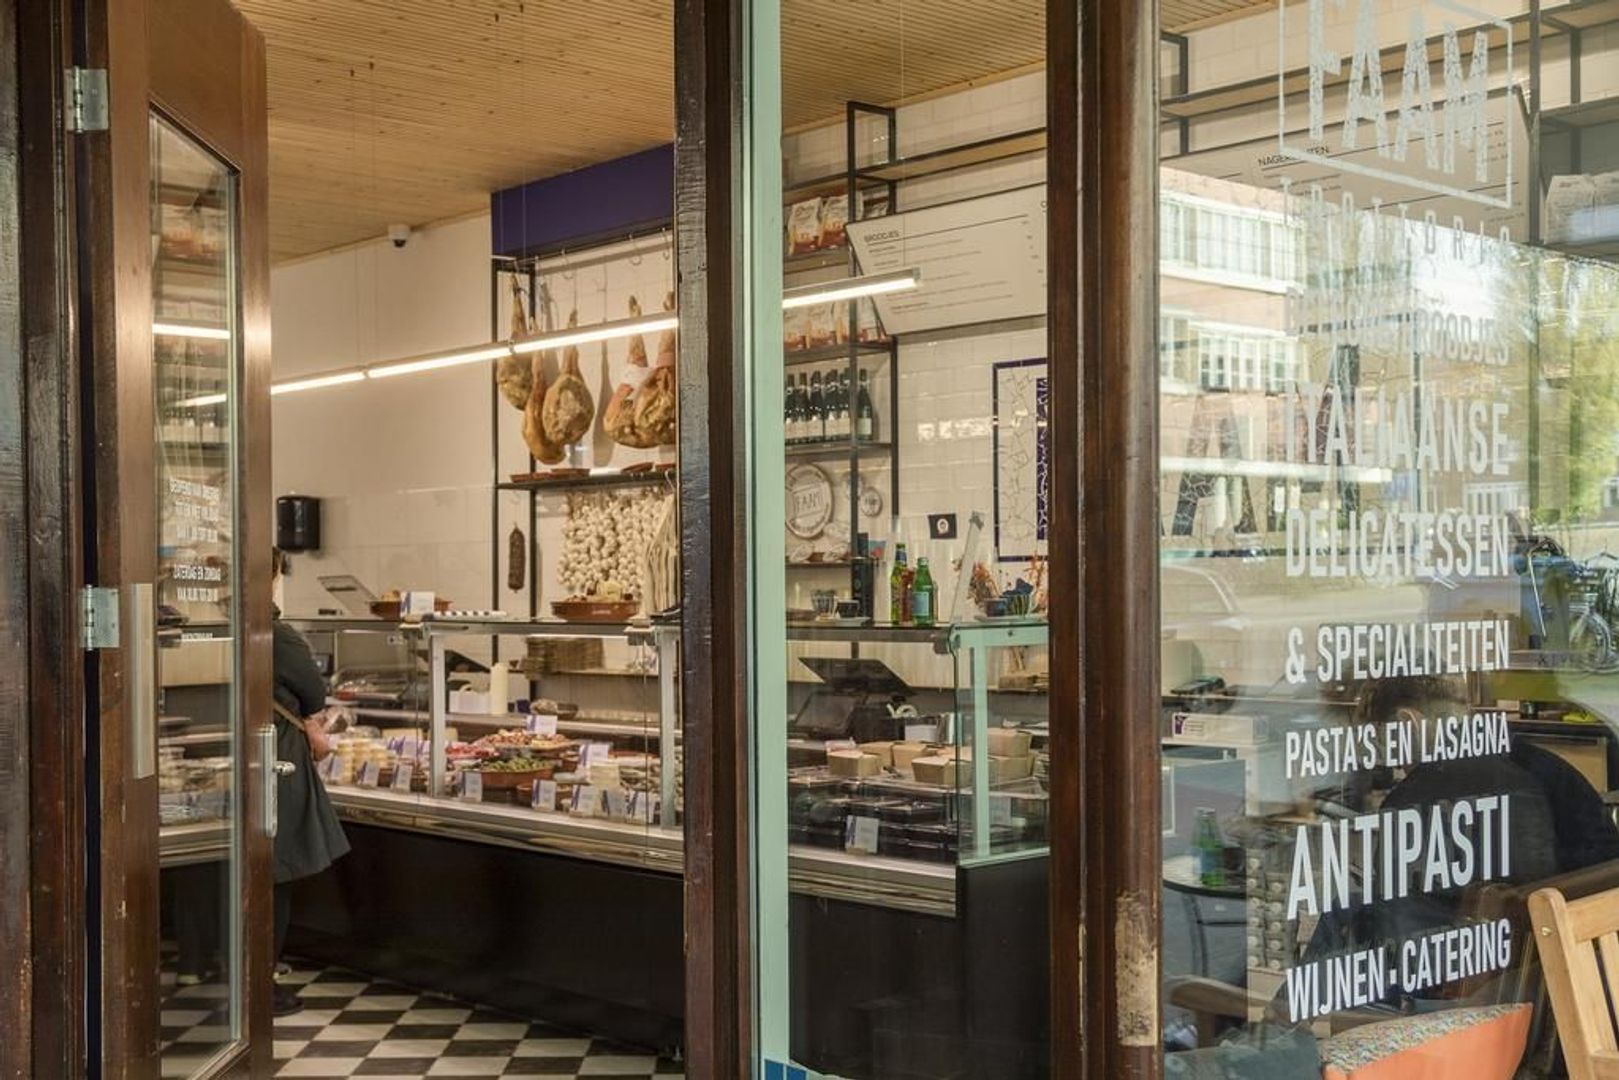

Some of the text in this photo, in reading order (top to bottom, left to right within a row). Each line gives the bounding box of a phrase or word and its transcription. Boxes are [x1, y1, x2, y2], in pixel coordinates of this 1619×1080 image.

[1403, 303, 1509, 366] ROODJES
[1285, 381, 1510, 476] ITALIAANSE
[1285, 507, 1510, 577] DELICATESSEN
[1286, 620, 1510, 684] & SPECIALITEITEN
[1286, 711, 1512, 779] PASTA'S EN LASAGNA
[1286, 794, 1511, 921] ANTIPASTI
